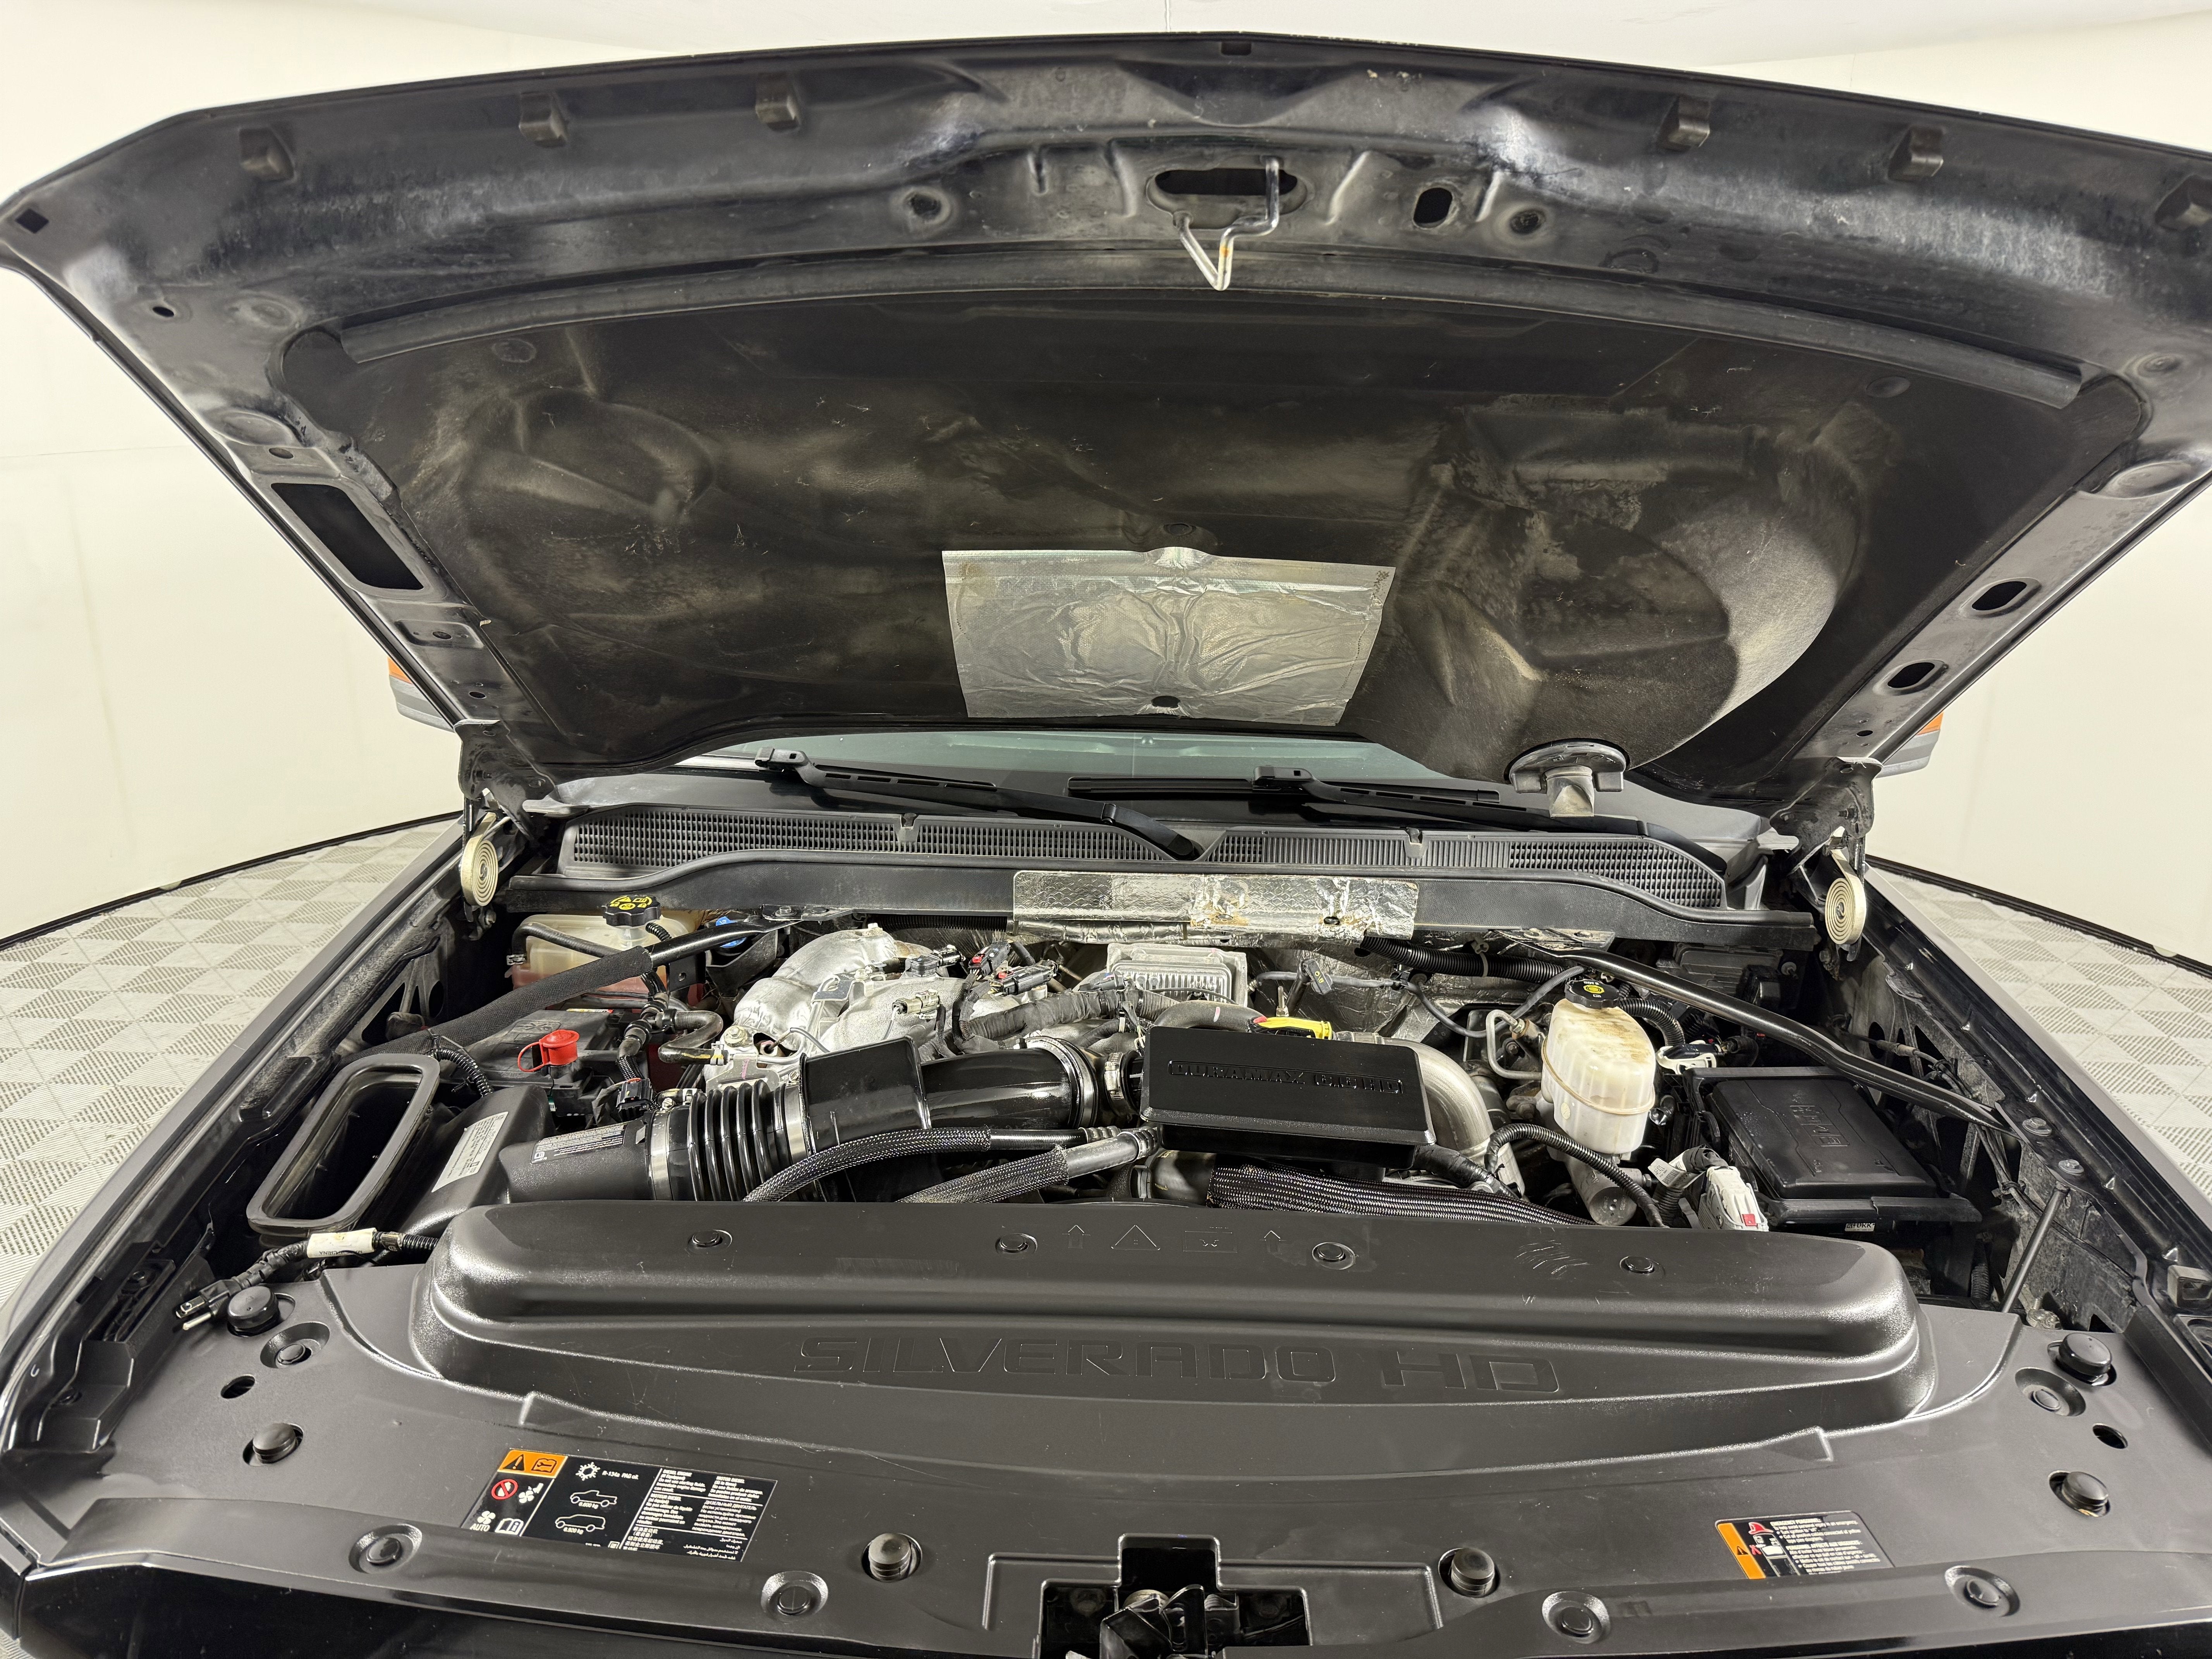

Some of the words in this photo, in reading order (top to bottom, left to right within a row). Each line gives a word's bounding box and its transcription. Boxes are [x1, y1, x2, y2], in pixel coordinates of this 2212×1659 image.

[1171, 1063, 1305, 1084] DURAMAX
[794, 1336, 1336, 1382] SILVERADO
[1381, 1351, 1559, 1393] HD
[469, 1523, 491, 1532] AUTO
